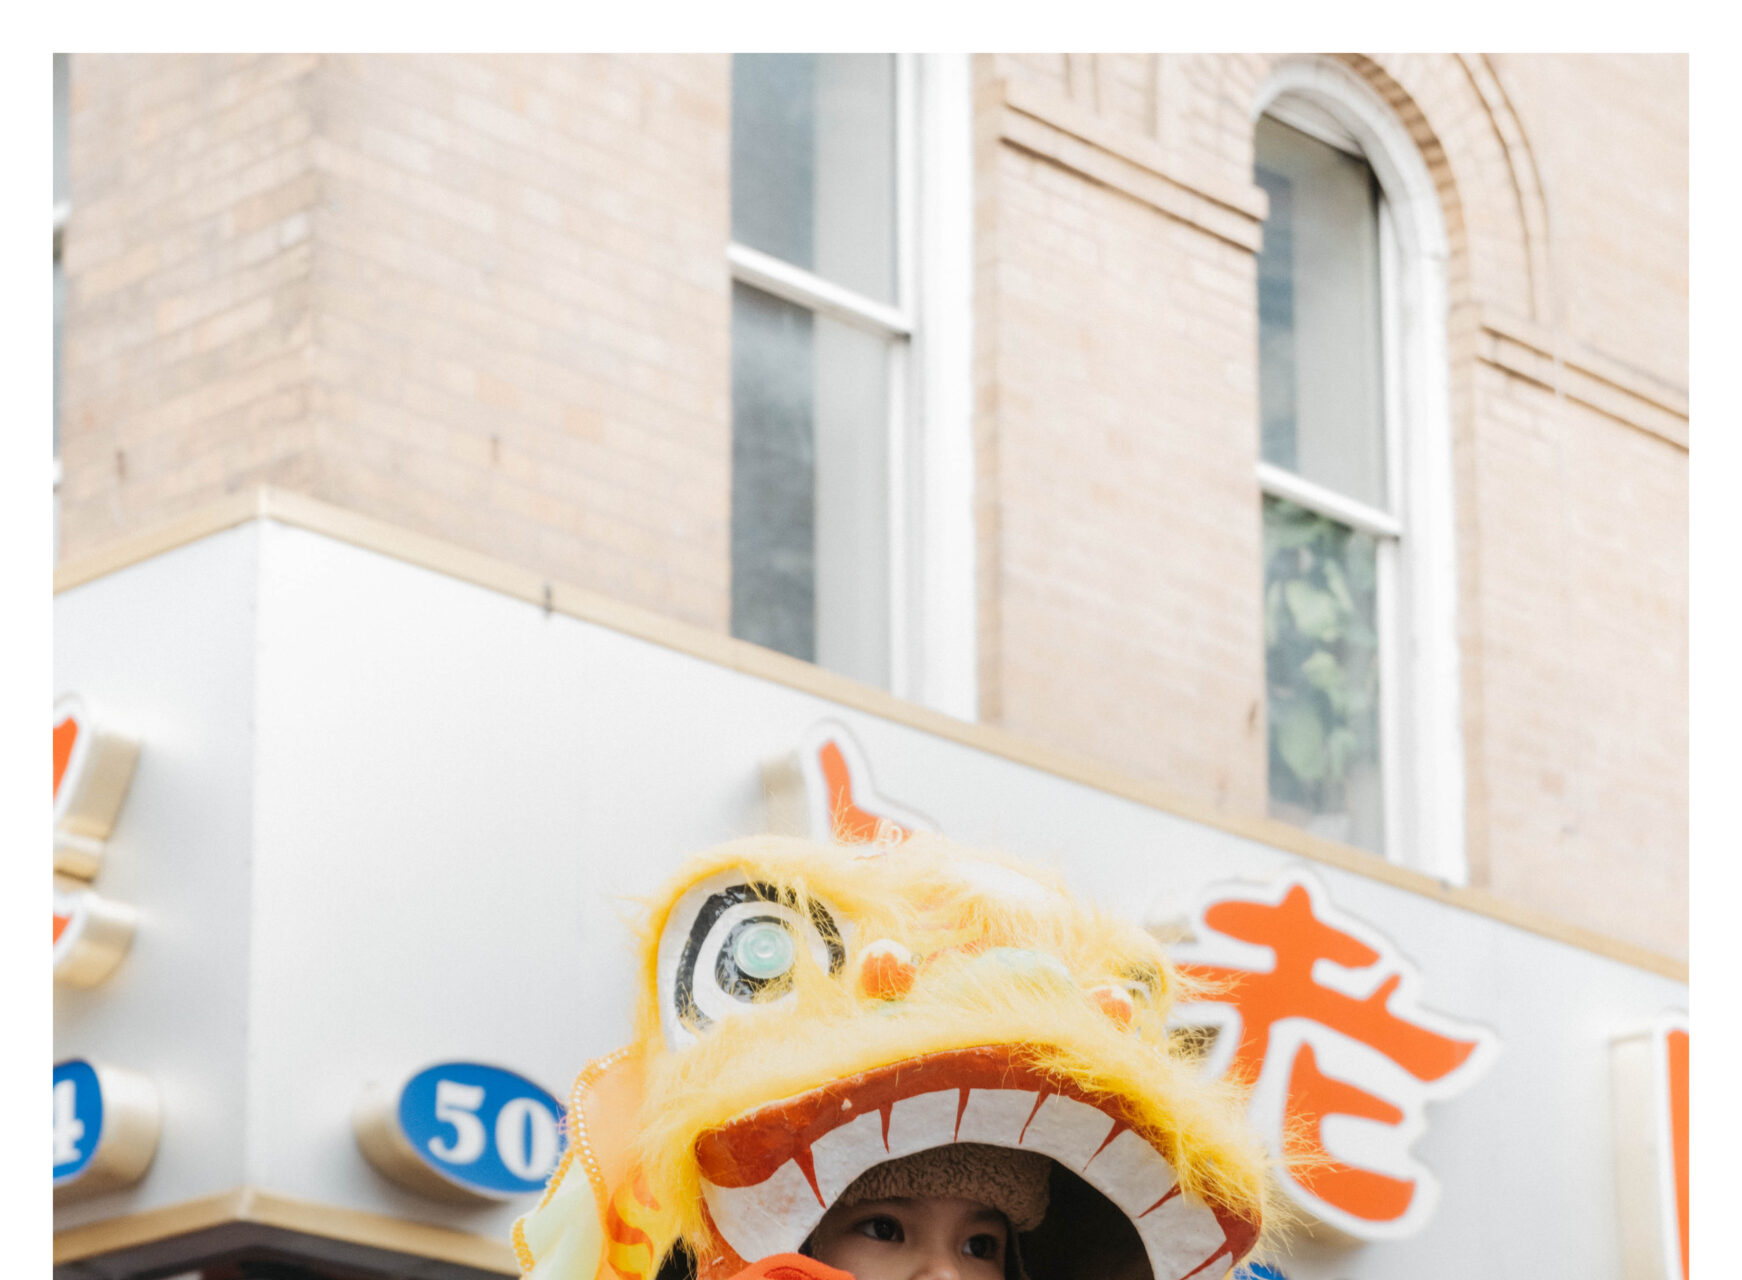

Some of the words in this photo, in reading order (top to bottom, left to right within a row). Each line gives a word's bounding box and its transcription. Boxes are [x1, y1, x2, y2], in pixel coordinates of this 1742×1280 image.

[1174, 884, 1479, 1222] 老
[53, 1080, 84, 1167] 4
[428, 1080, 558, 1180] 50
